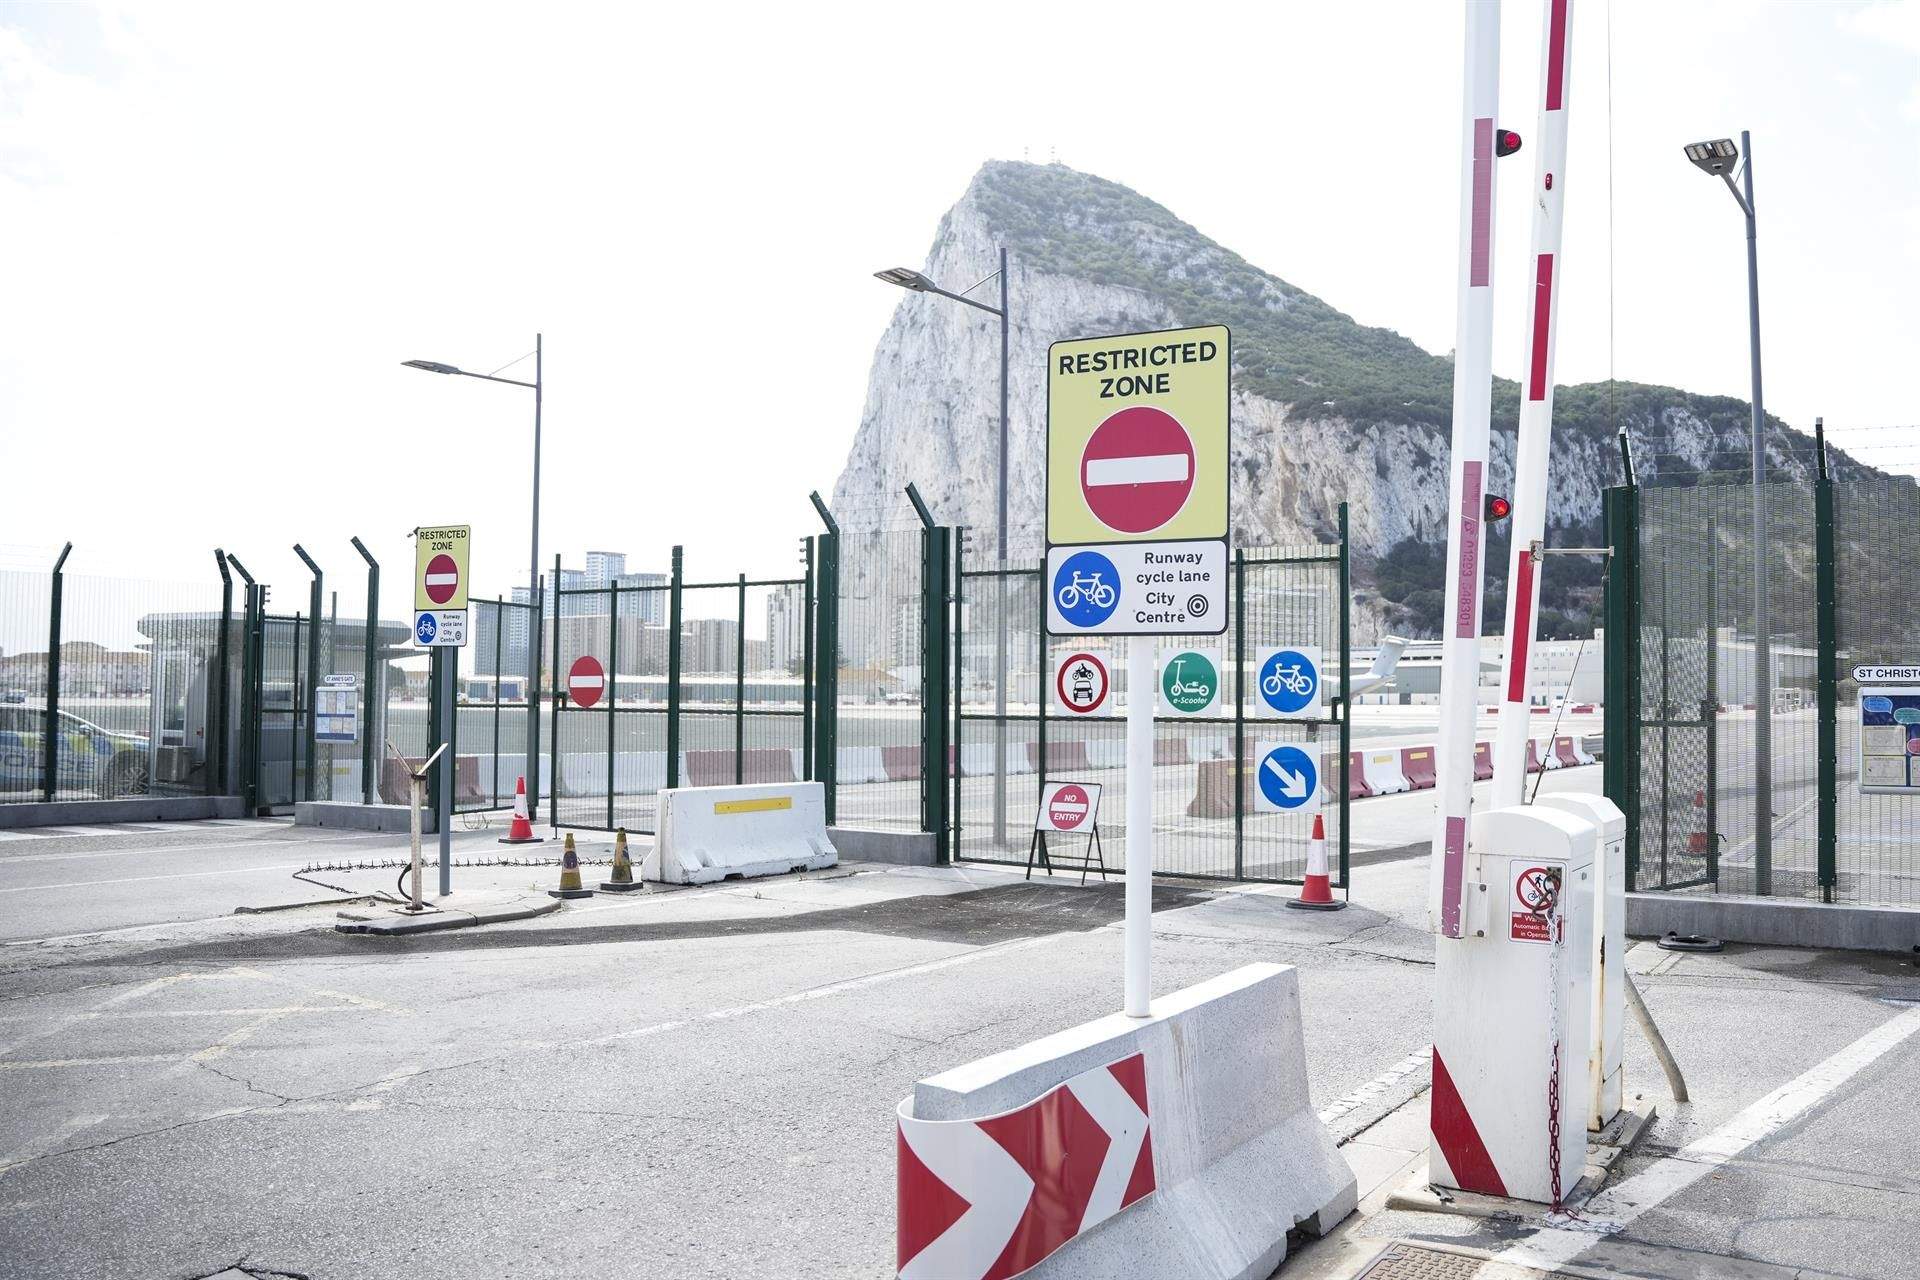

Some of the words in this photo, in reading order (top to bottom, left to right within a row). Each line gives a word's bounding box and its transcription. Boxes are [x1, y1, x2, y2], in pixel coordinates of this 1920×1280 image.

[1059, 341, 1217, 375] RESTRICTED
[1100, 373, 1170, 399] ZONE
[419, 530, 467, 540] RESTRICTED
[431, 541, 453, 551] ZONE
[1144, 552, 1203, 565] Runway
[1136, 570, 1174, 585] cycle
[1179, 570, 1210, 582] lane
[1146, 592, 1175, 606] City
[1135, 610, 1186, 624] Centre
[1859, 669, 1873, 678] ST
[1876, 669, 1920, 678] CHRIST
[1173, 696, 1208, 705] e-Scooter
[1063, 794, 1077, 802] NO
[1053, 812, 1081, 822] ENTRY
